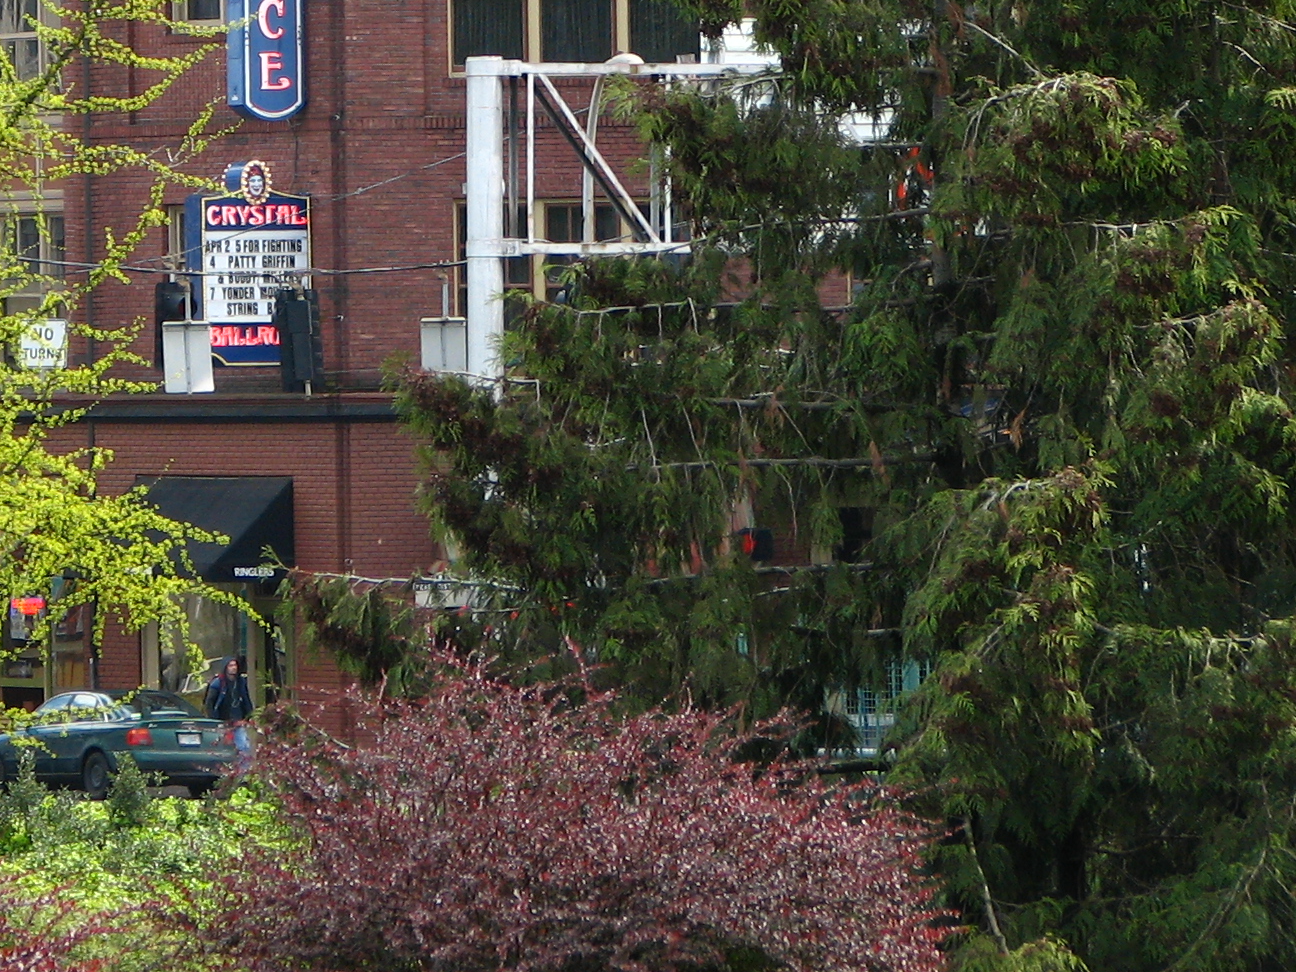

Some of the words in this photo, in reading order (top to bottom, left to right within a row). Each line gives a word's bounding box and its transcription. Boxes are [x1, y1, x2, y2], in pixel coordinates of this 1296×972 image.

[206, 204, 309, 226] CRYSTAL
[206, 239, 222, 253] APR
[225, 239, 231, 253] 2
[235, 239, 242, 253] 5
[244, 239, 260, 253] FOR
[262, 239, 303, 253] FIGHTING
[210, 255, 216, 269] 4
[228, 255, 257, 269] PATTY
[262, 255, 296, 269] GRIFFIN
[229, 271, 257, 284] BUDDY
[210, 287, 216, 301] 7
[222, 287, 256, 300] YONDER
[227, 302, 259, 316] STRING
